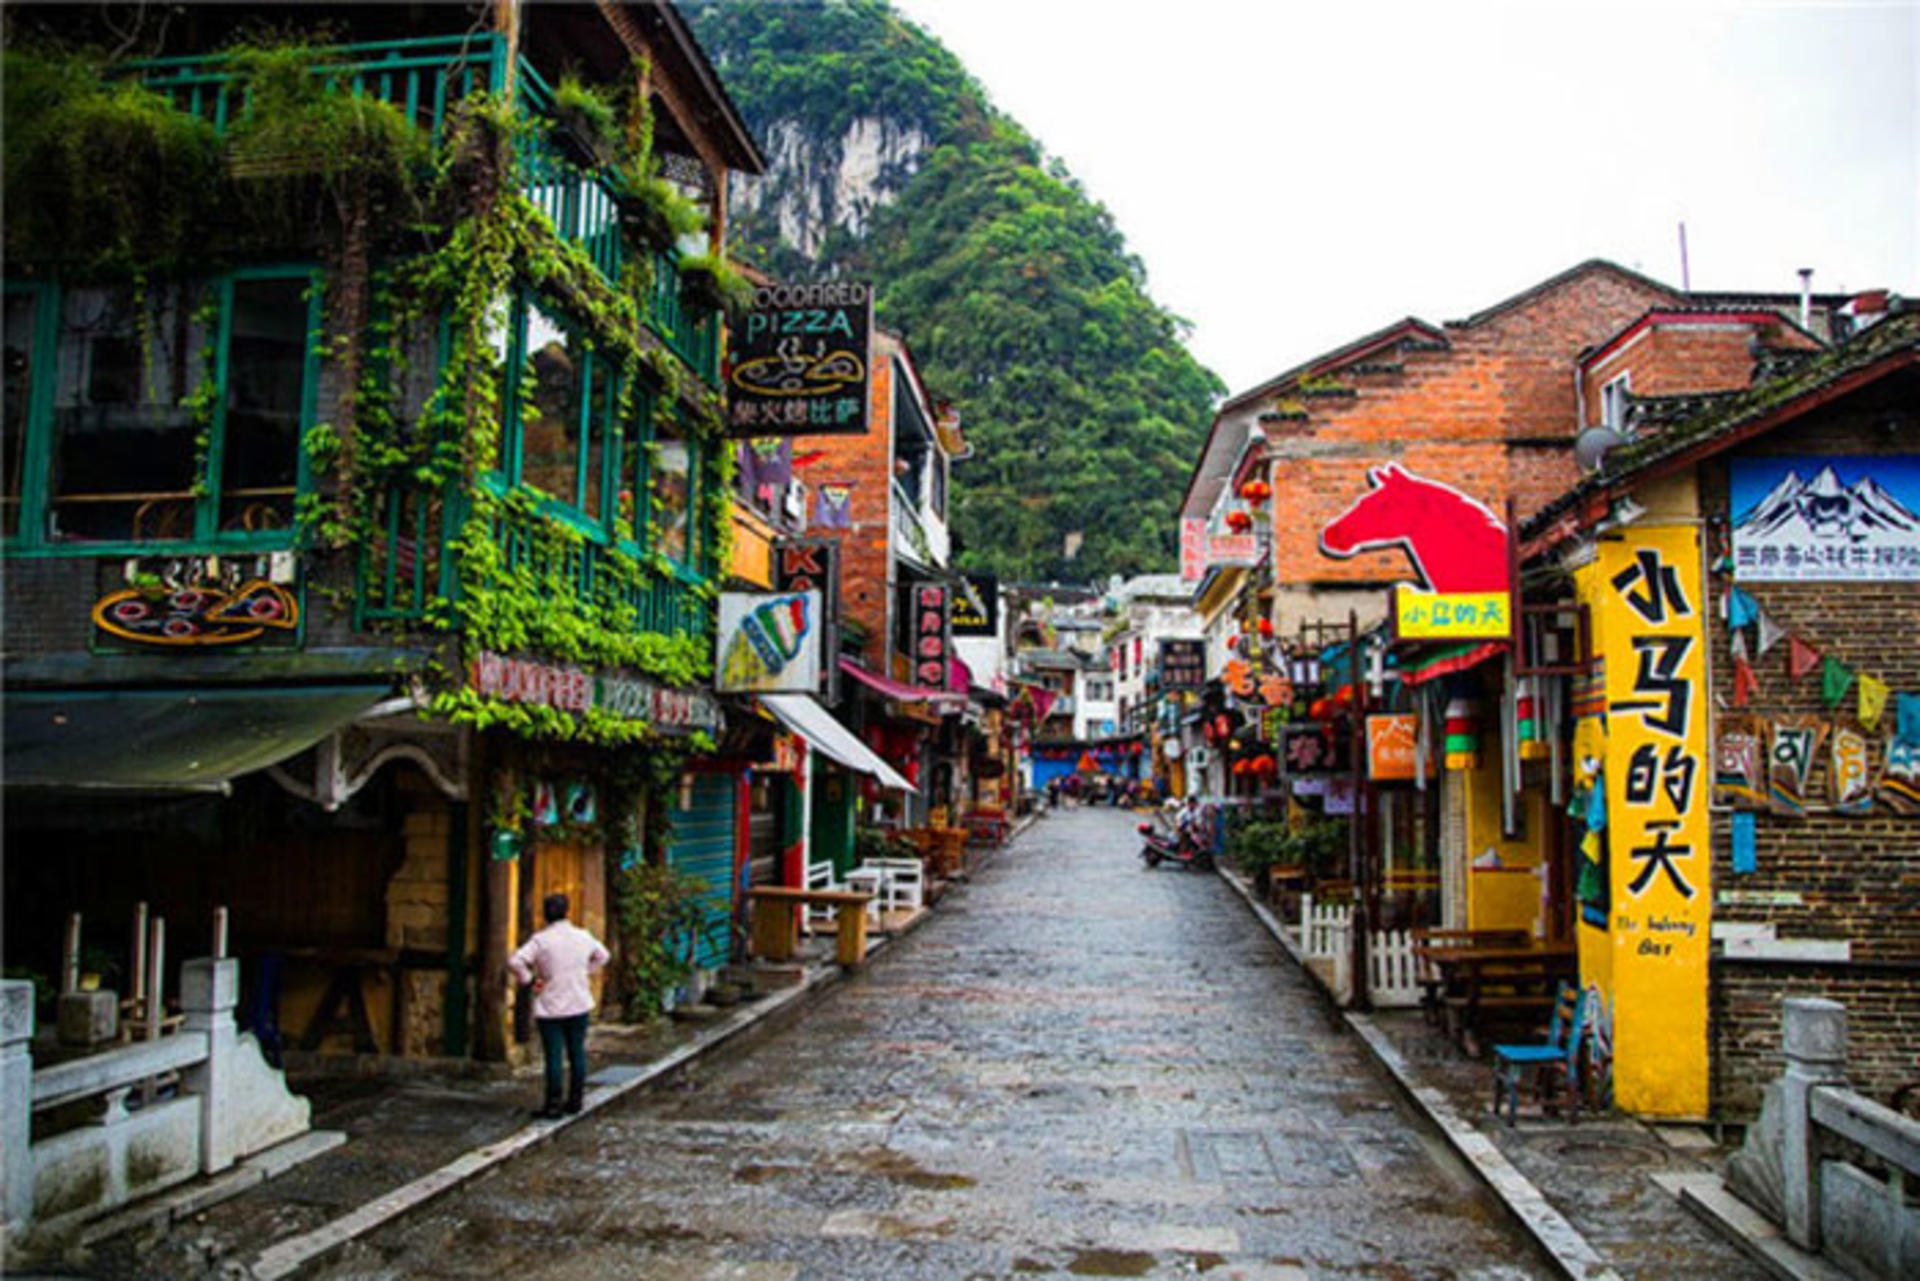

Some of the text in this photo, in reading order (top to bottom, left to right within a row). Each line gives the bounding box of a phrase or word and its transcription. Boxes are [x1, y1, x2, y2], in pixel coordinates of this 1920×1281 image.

[748, 309, 853, 343] PIZZA
[1610, 549, 1696, 902] 小马的天
